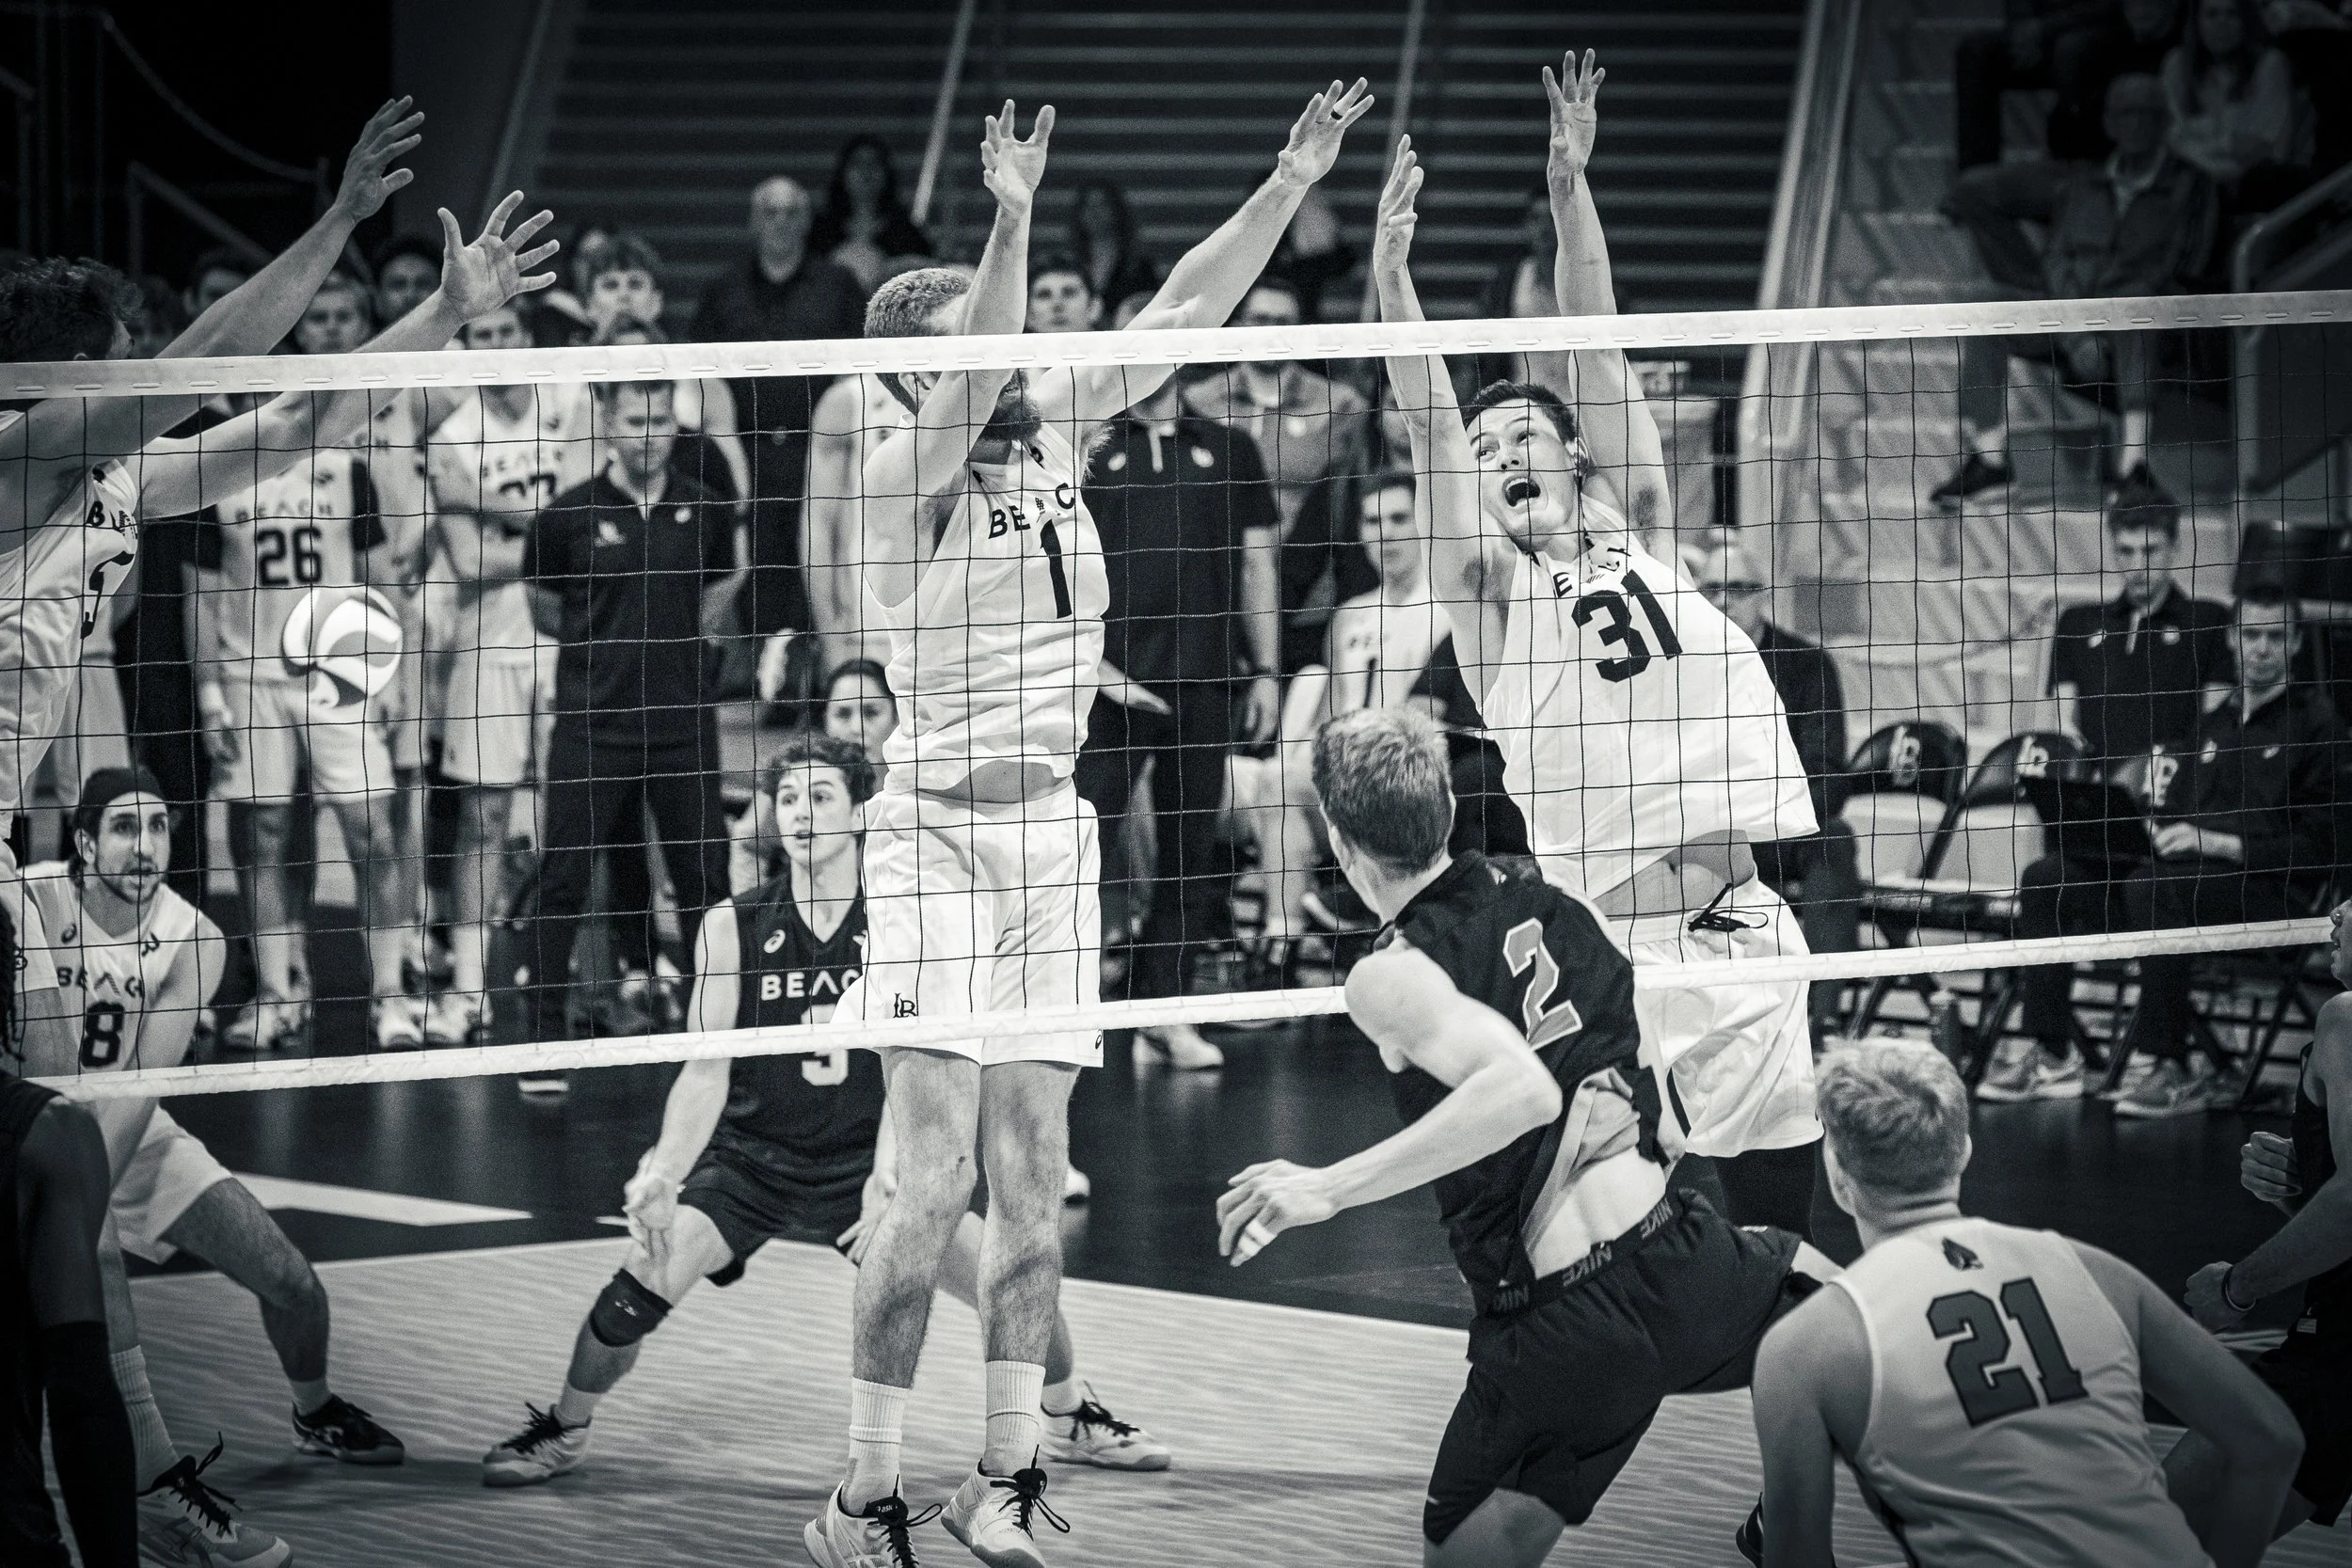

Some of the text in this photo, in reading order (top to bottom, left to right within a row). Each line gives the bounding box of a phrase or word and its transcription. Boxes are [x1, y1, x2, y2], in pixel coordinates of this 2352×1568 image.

[988, 482, 1074, 539] BEC
[257, 526, 323, 587] 26
[1040, 518, 1073, 619] 1
[1571, 569, 1684, 683] 31
[760, 968, 863, 1001] BEAC
[1503, 917, 1582, 1053] 2
[81, 1000, 124, 1068] 8
[1640, 1197, 1674, 1240] NIKE
[1563, 1243, 1613, 1287] NIKE
[1926, 1276, 2090, 1429] 21
